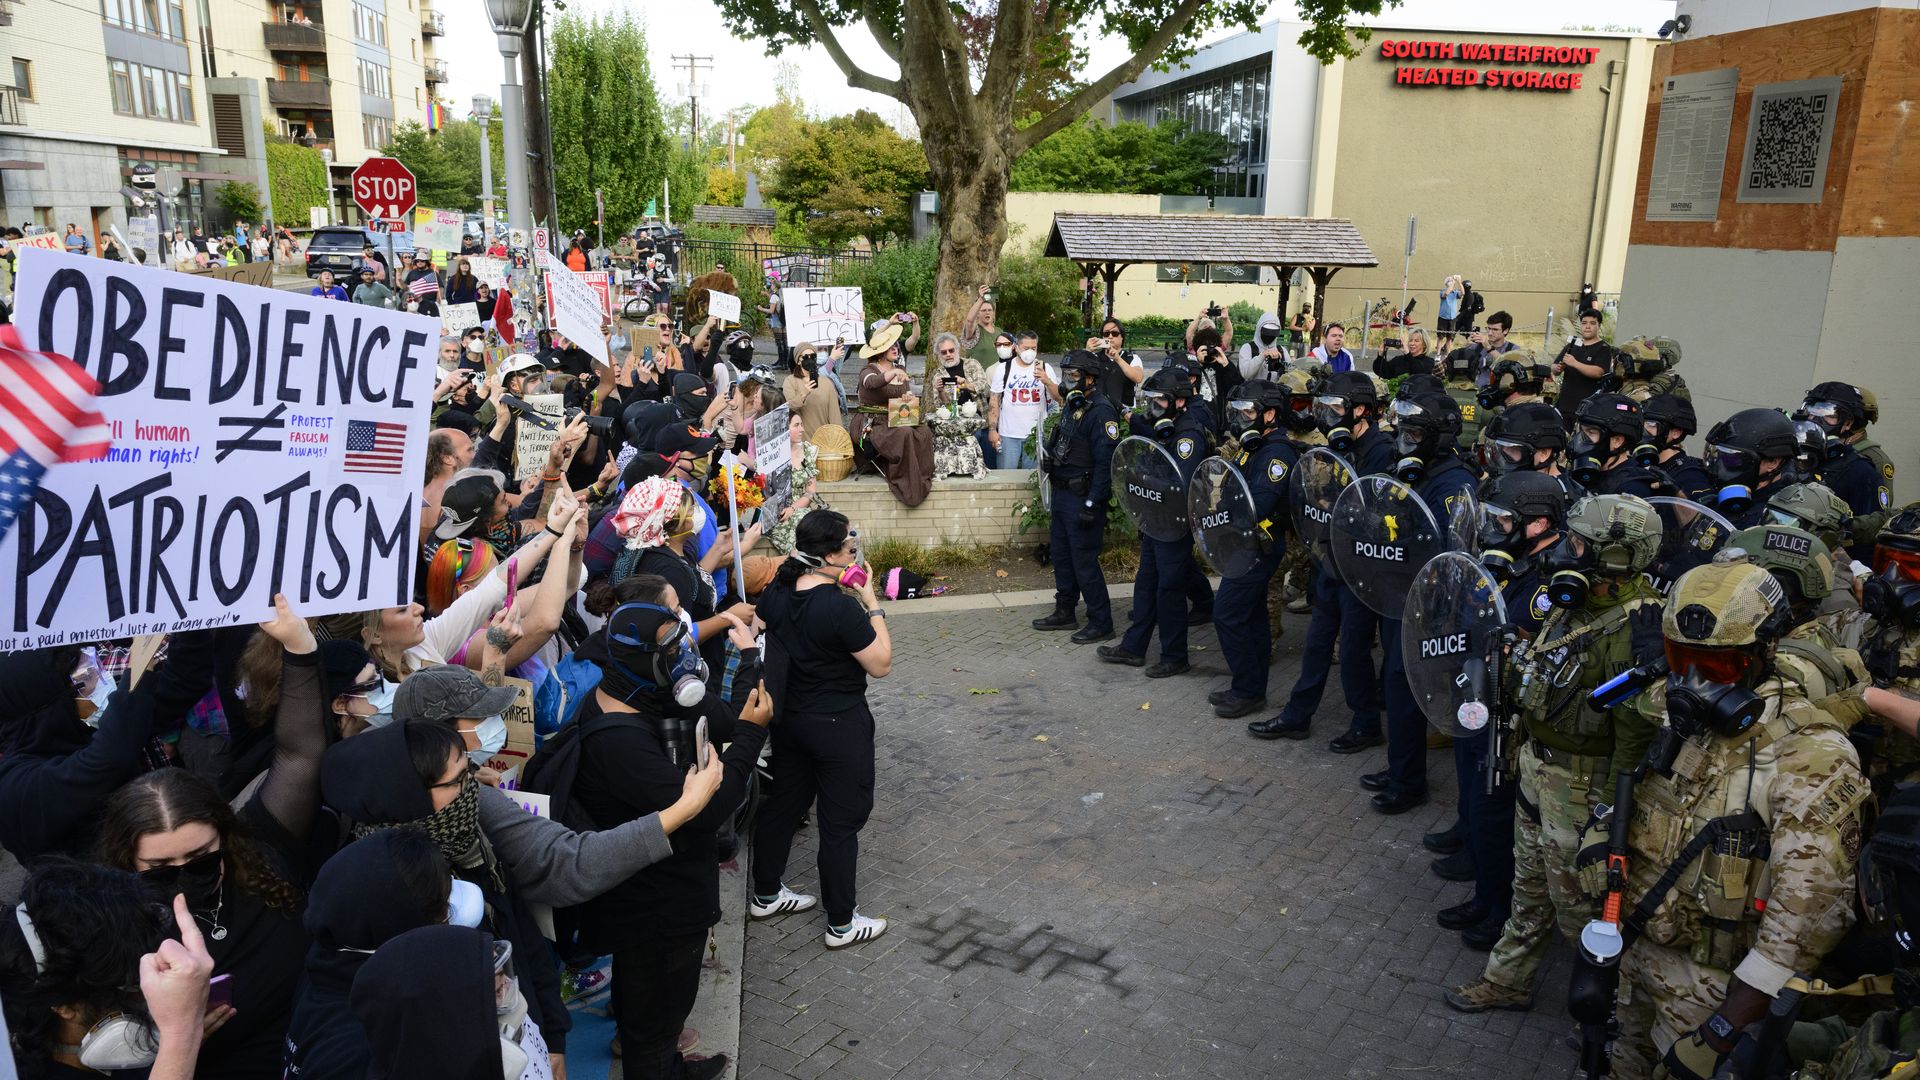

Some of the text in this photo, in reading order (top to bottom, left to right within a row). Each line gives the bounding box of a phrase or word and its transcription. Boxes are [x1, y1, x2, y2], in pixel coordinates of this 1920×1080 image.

[1381, 40, 1600, 65] SOUTH WATERFRONT
[1396, 67, 1583, 90] HEATED STORAGE
[358, 176, 412, 201] STOP
[437, 218, 460, 226] LIGHT
[446, 308, 464, 319] STOP
[804, 288, 862, 321] FUCK
[38, 268, 428, 408] OBEDIENCE
[803, 318, 859, 343] ICE!
[1008, 374, 1040, 388] Fuck
[1011, 388, 1041, 403] ICE
[540, 403, 558, 413] STATE
[135, 419, 190, 442] human
[291, 414, 334, 429] PROTEST
[290, 431, 329, 443] FASCISM
[150, 446, 200, 470] rights!
[288, 446, 328, 458] ALWAYS!
[1128, 483, 1162, 503] POLICE
[1201, 510, 1230, 530] POLICE
[1304, 504, 1332, 524] POLIC
[13, 471, 413, 633] PATRIOTISM
[1355, 541, 1404, 562] POLICE
[1766, 533, 1810, 554] POLICE
[22, 637, 34, 648] a
[38, 630, 64, 647] paid
[69, 622, 124, 643] protestor!
[152, 622, 167, 633] an
[172, 618, 202, 633] angry
[205, 611, 232, 629] girl!
[1422, 633, 1467, 658] POLICE
